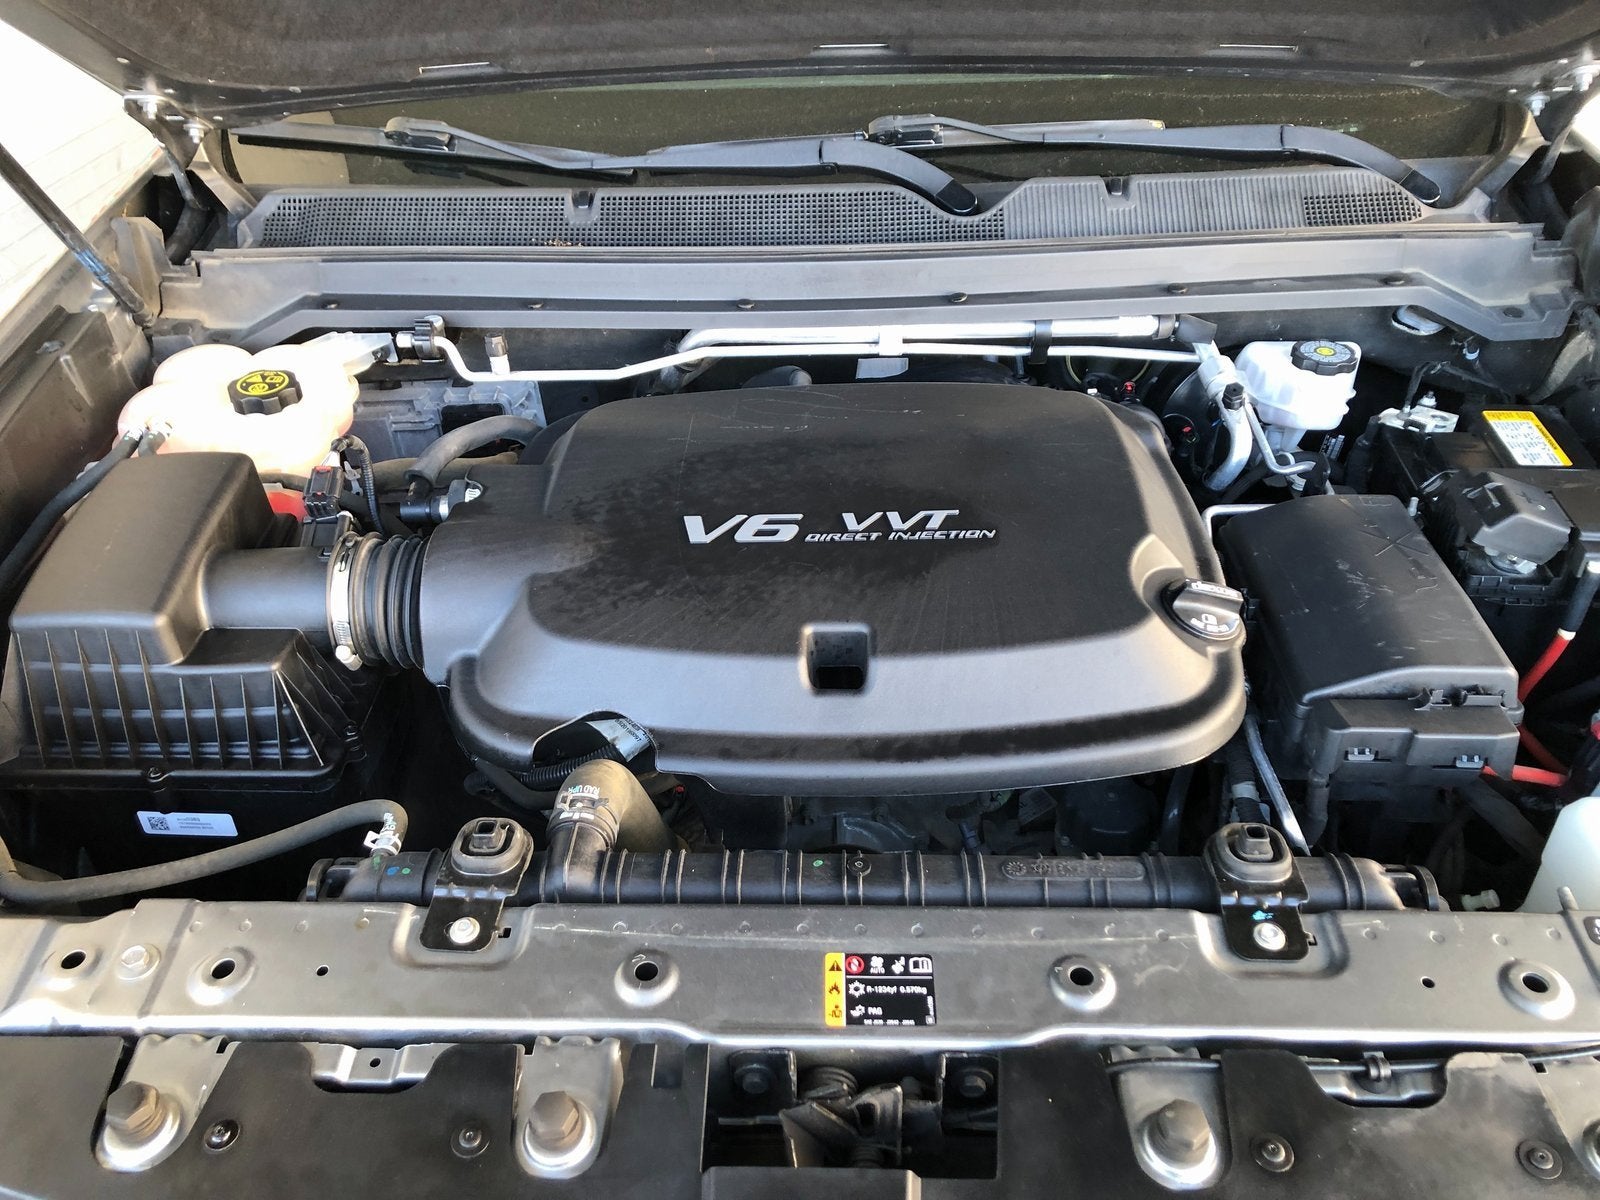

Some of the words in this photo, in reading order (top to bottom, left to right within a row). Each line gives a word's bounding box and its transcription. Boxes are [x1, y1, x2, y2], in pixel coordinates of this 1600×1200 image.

[683, 513, 804, 544] V6
[841, 509, 960, 532] VVT
[804, 532, 883, 542] DIRECT
[888, 529, 997, 541] INJECTION
